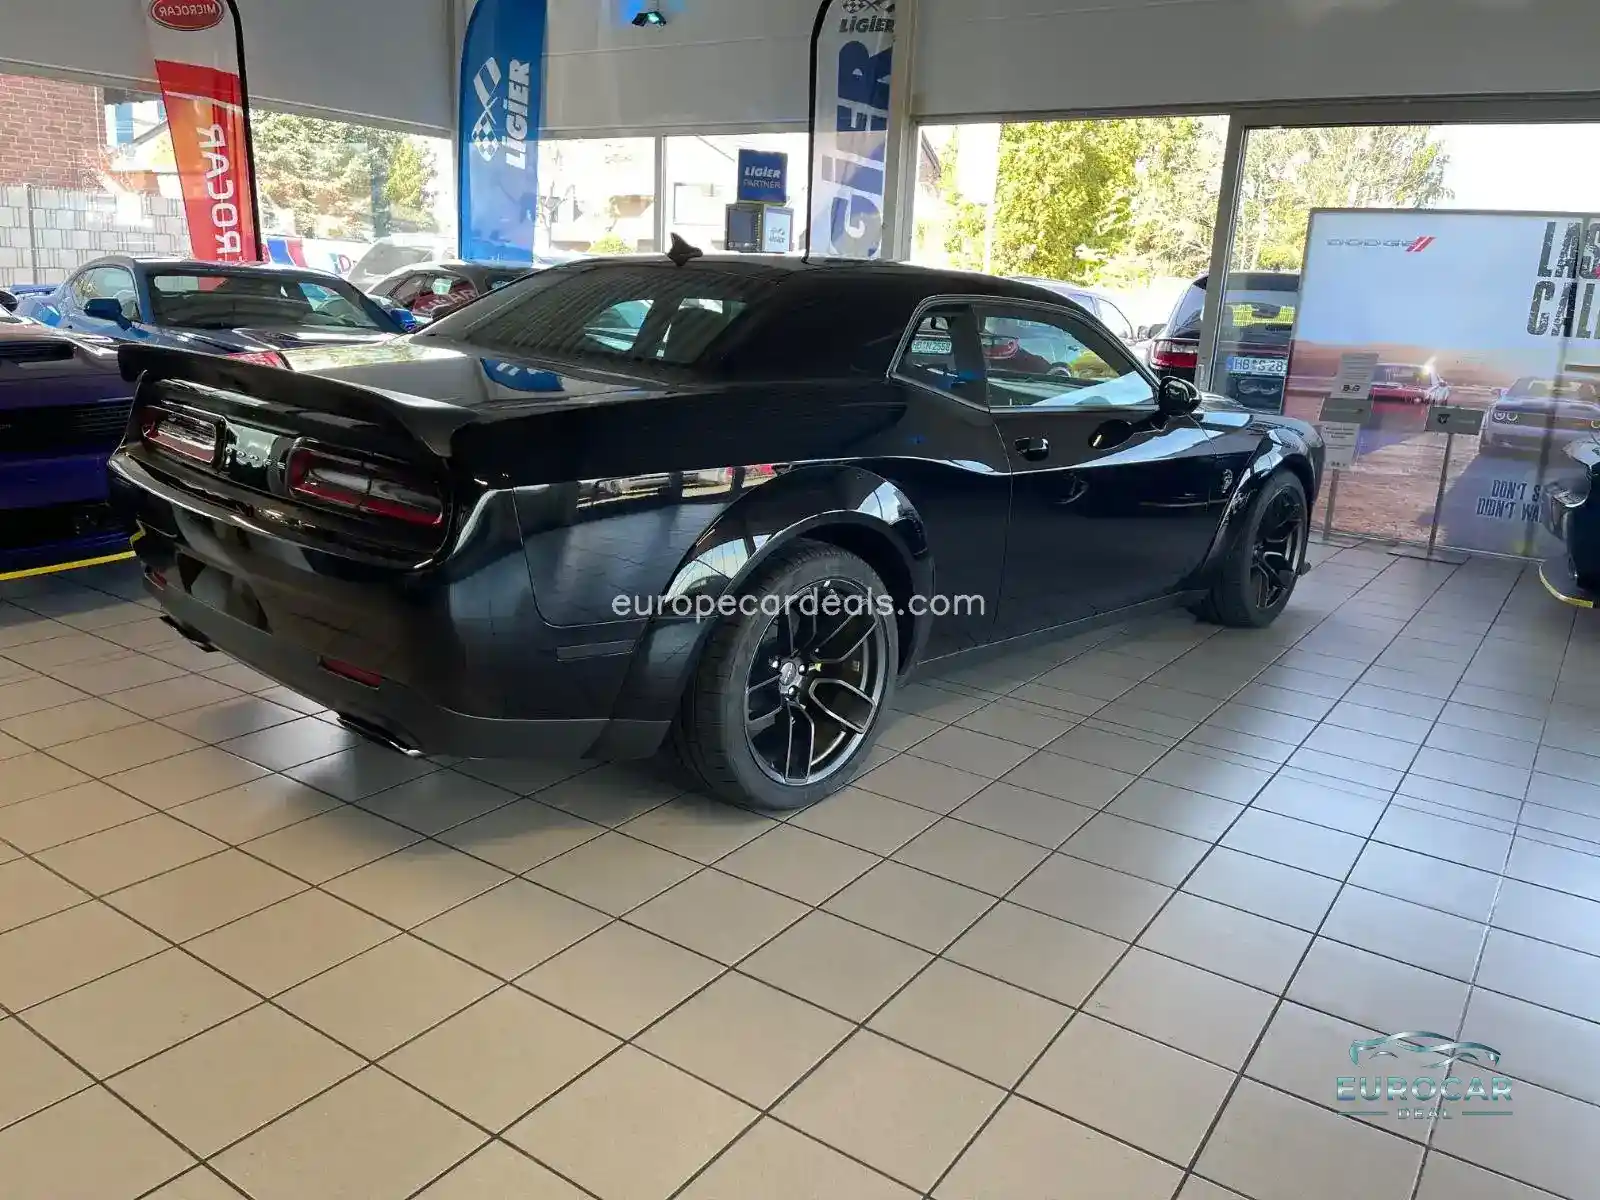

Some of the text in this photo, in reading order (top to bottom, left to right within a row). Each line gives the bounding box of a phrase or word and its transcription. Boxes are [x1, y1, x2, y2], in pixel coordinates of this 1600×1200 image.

[743, 179, 781, 189] PARTNER
[1491, 479, 1527, 500] DON'T
[1476, 497, 1516, 519] DIDN'T
